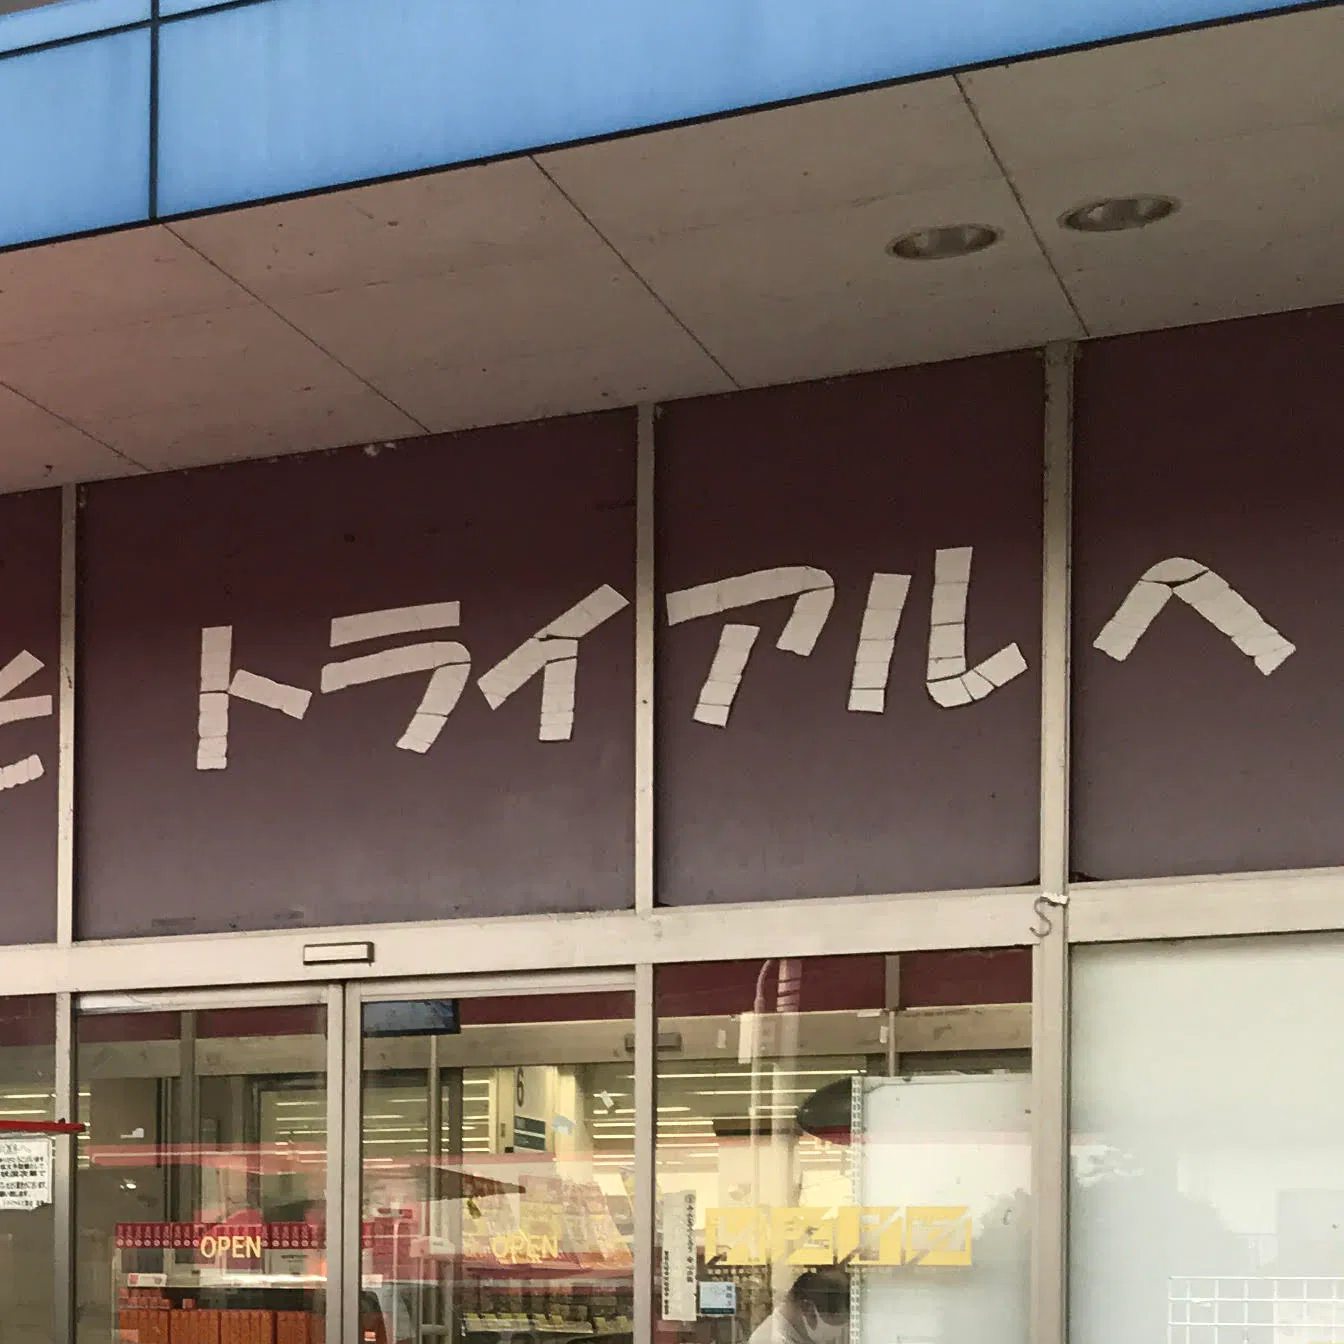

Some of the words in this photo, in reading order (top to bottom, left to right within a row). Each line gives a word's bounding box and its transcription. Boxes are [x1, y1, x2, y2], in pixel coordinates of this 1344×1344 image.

[194, 546, 1298, 772] トライアルへ
[200, 1235, 262, 1259] OPEN
[491, 1234, 559, 1261] OPEN
